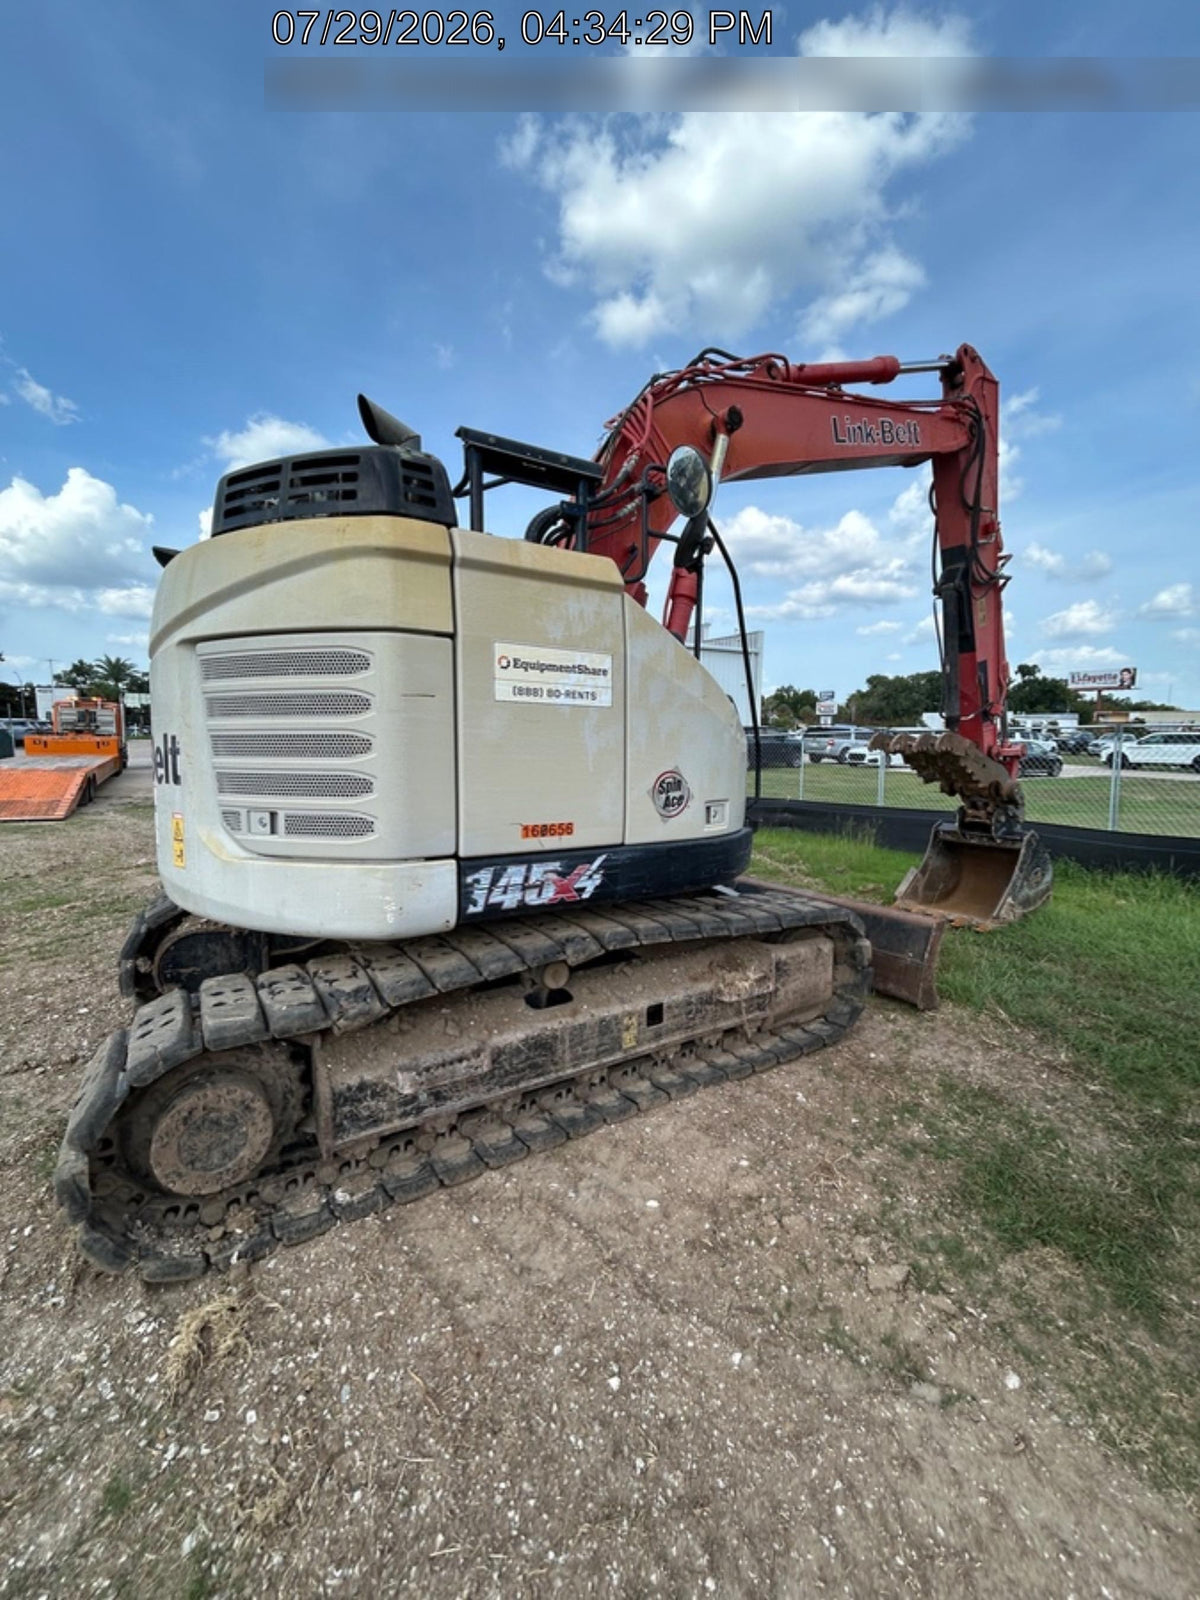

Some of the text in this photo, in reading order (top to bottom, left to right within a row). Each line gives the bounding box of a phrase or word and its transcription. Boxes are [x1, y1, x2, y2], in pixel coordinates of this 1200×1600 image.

[831, 416, 921, 447] Link-Belt
[512, 657, 608, 677] EquipmentShare
[512, 685, 544, 698] (888)
[154, 733, 181, 786] elt
